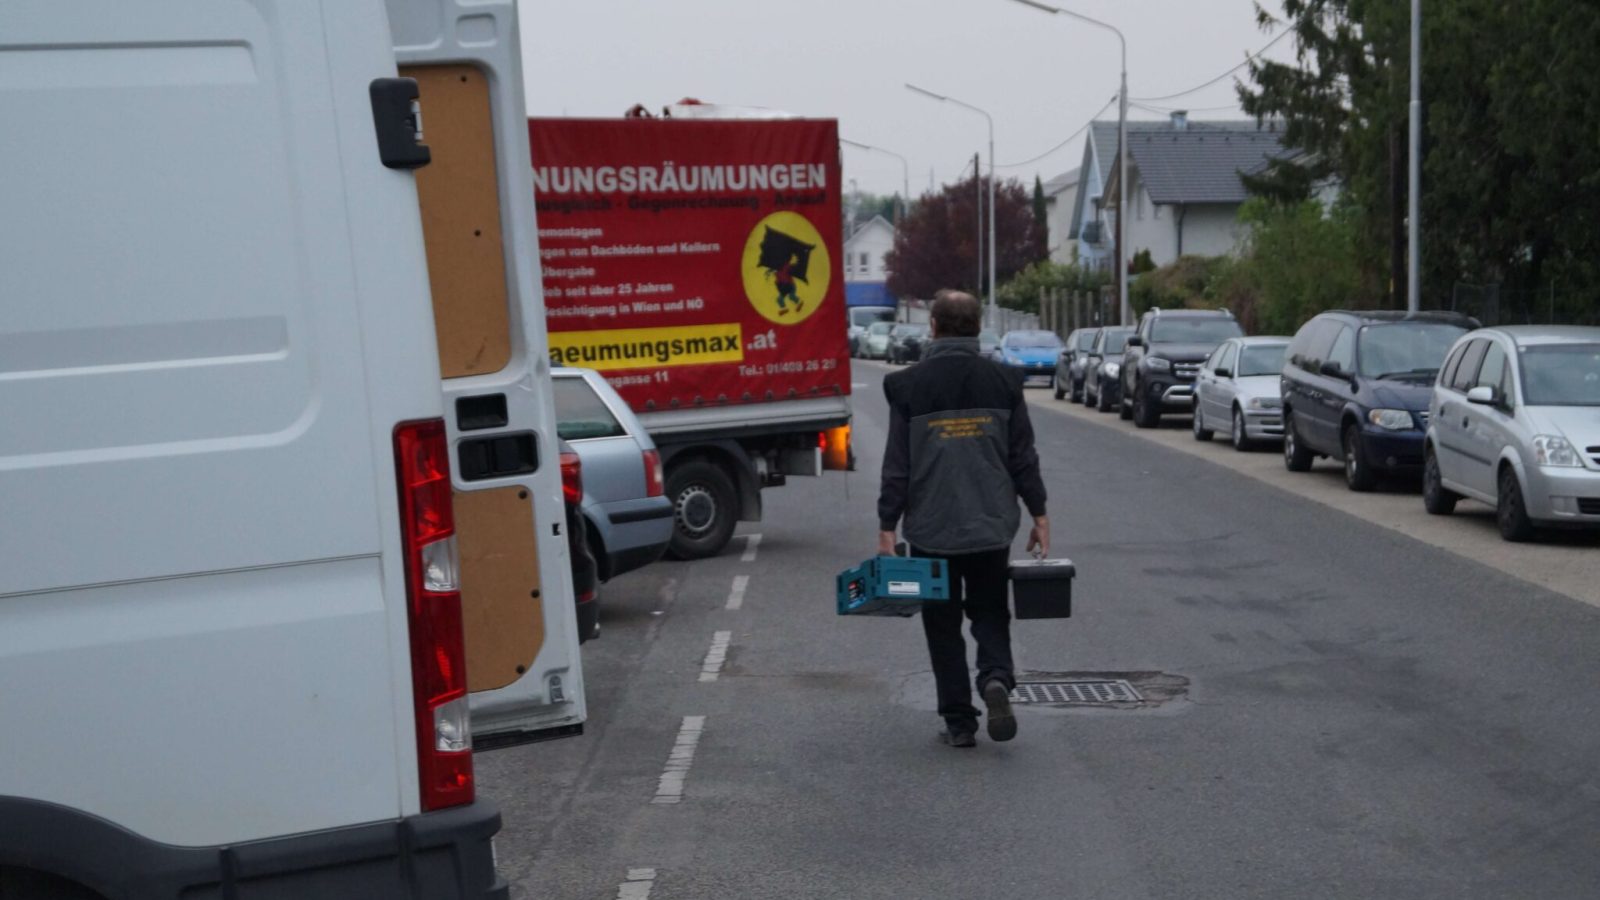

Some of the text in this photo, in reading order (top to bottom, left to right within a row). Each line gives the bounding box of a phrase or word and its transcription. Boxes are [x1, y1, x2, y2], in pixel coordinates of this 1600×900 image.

[568, 248, 589, 257] von
[590, 244, 654, 256] Dachböden
[656, 242, 677, 254] und
[680, 241, 721, 253] Kellern
[565, 285, 587, 297] seit
[589, 283, 615, 296] über
[617, 282, 633, 294] 25
[635, 281, 674, 294] Jahren
[619, 302, 630, 313] in
[632, 301, 660, 312] Wien
[663, 299, 684, 311] und
[549, 329, 777, 363] aeumungsmax .at
[654, 370, 669, 383] 11
